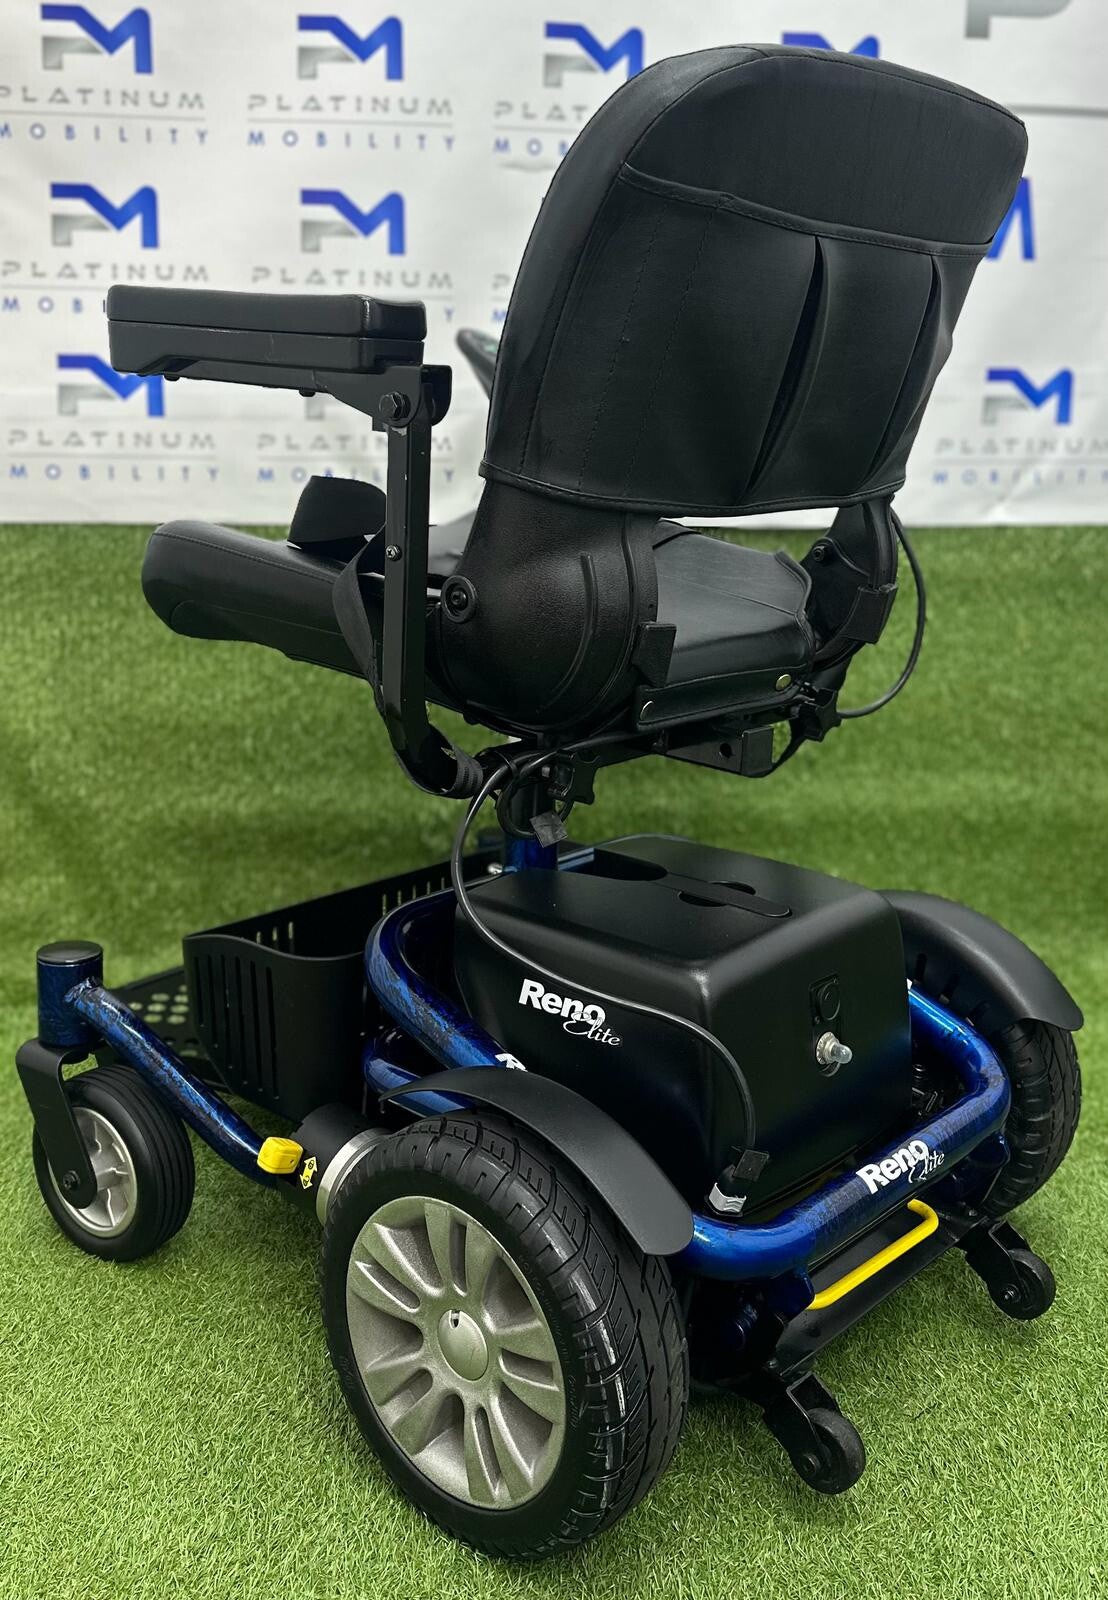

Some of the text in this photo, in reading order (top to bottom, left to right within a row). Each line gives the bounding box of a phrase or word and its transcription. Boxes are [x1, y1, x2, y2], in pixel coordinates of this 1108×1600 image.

[0, 86, 205, 109] PLATINUM
[248, 95, 454, 116] PLATINUM
[494, 101, 588, 121] PLAT
[0, 123, 208, 144] MOBILITY
[248, 130, 455, 151] MOBILITY
[2, 261, 209, 282] PLATINUM
[251, 266, 453, 289] PLATINUM
[8, 429, 215, 449] PLATINUM
[258, 434, 454, 451] PLATINM
[10, 464, 218, 482] MOBILITY
[518, 978, 606, 1025] Reno
[855, 1139, 929, 1195] Reno
